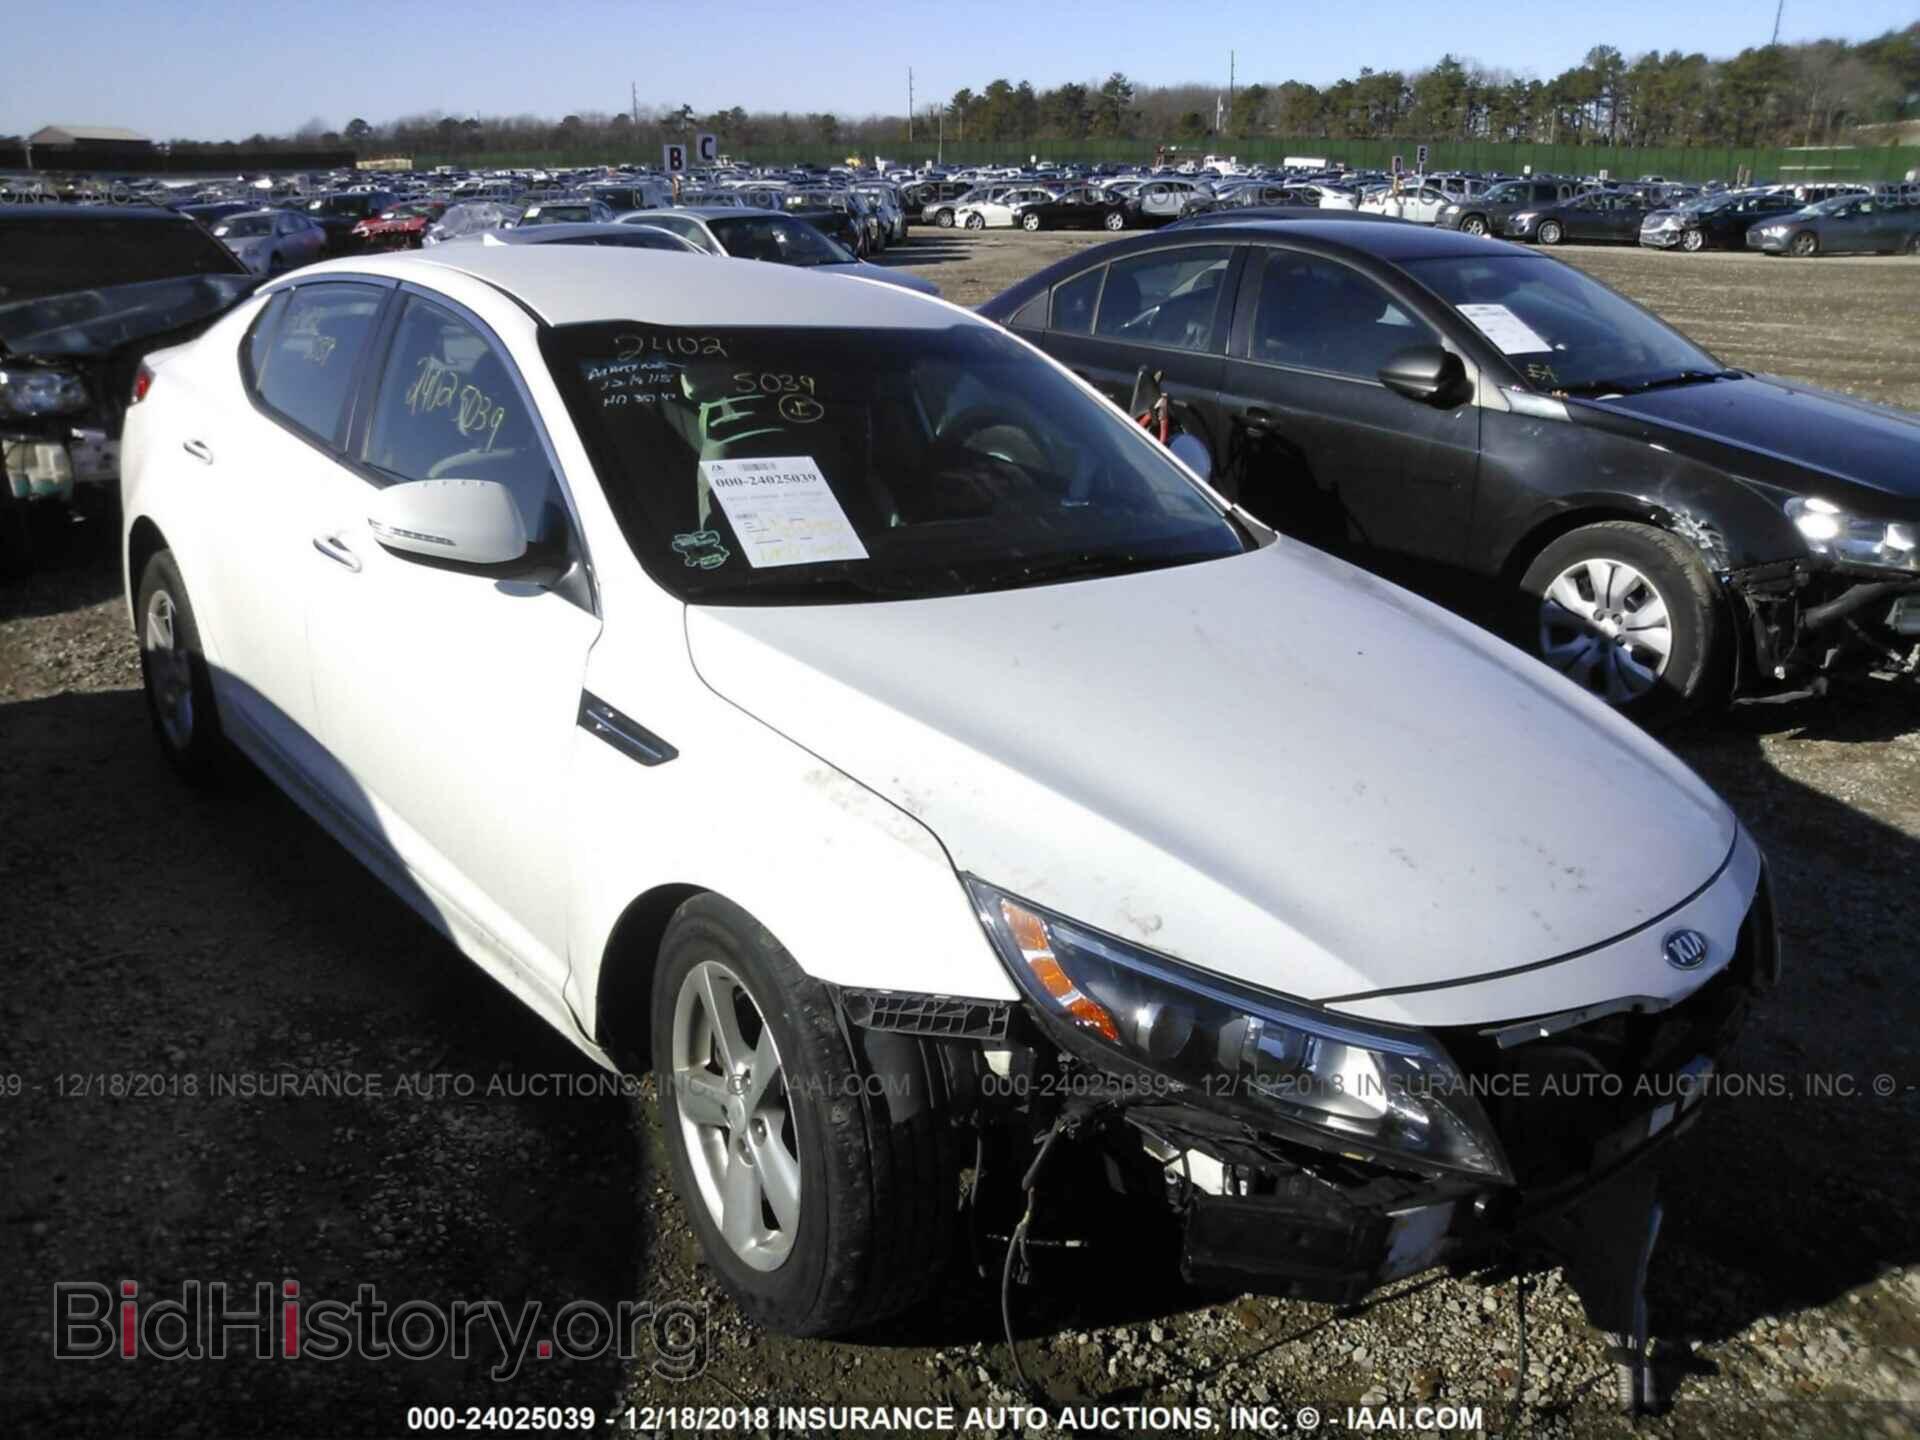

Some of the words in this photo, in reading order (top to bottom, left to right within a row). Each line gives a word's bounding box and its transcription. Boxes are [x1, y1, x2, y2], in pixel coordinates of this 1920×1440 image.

[670, 148, 682, 171] B
[701, 137, 713, 160] C
[733, 372, 815, 396] 5039
[715, 473, 817, 488] 000-24025039
